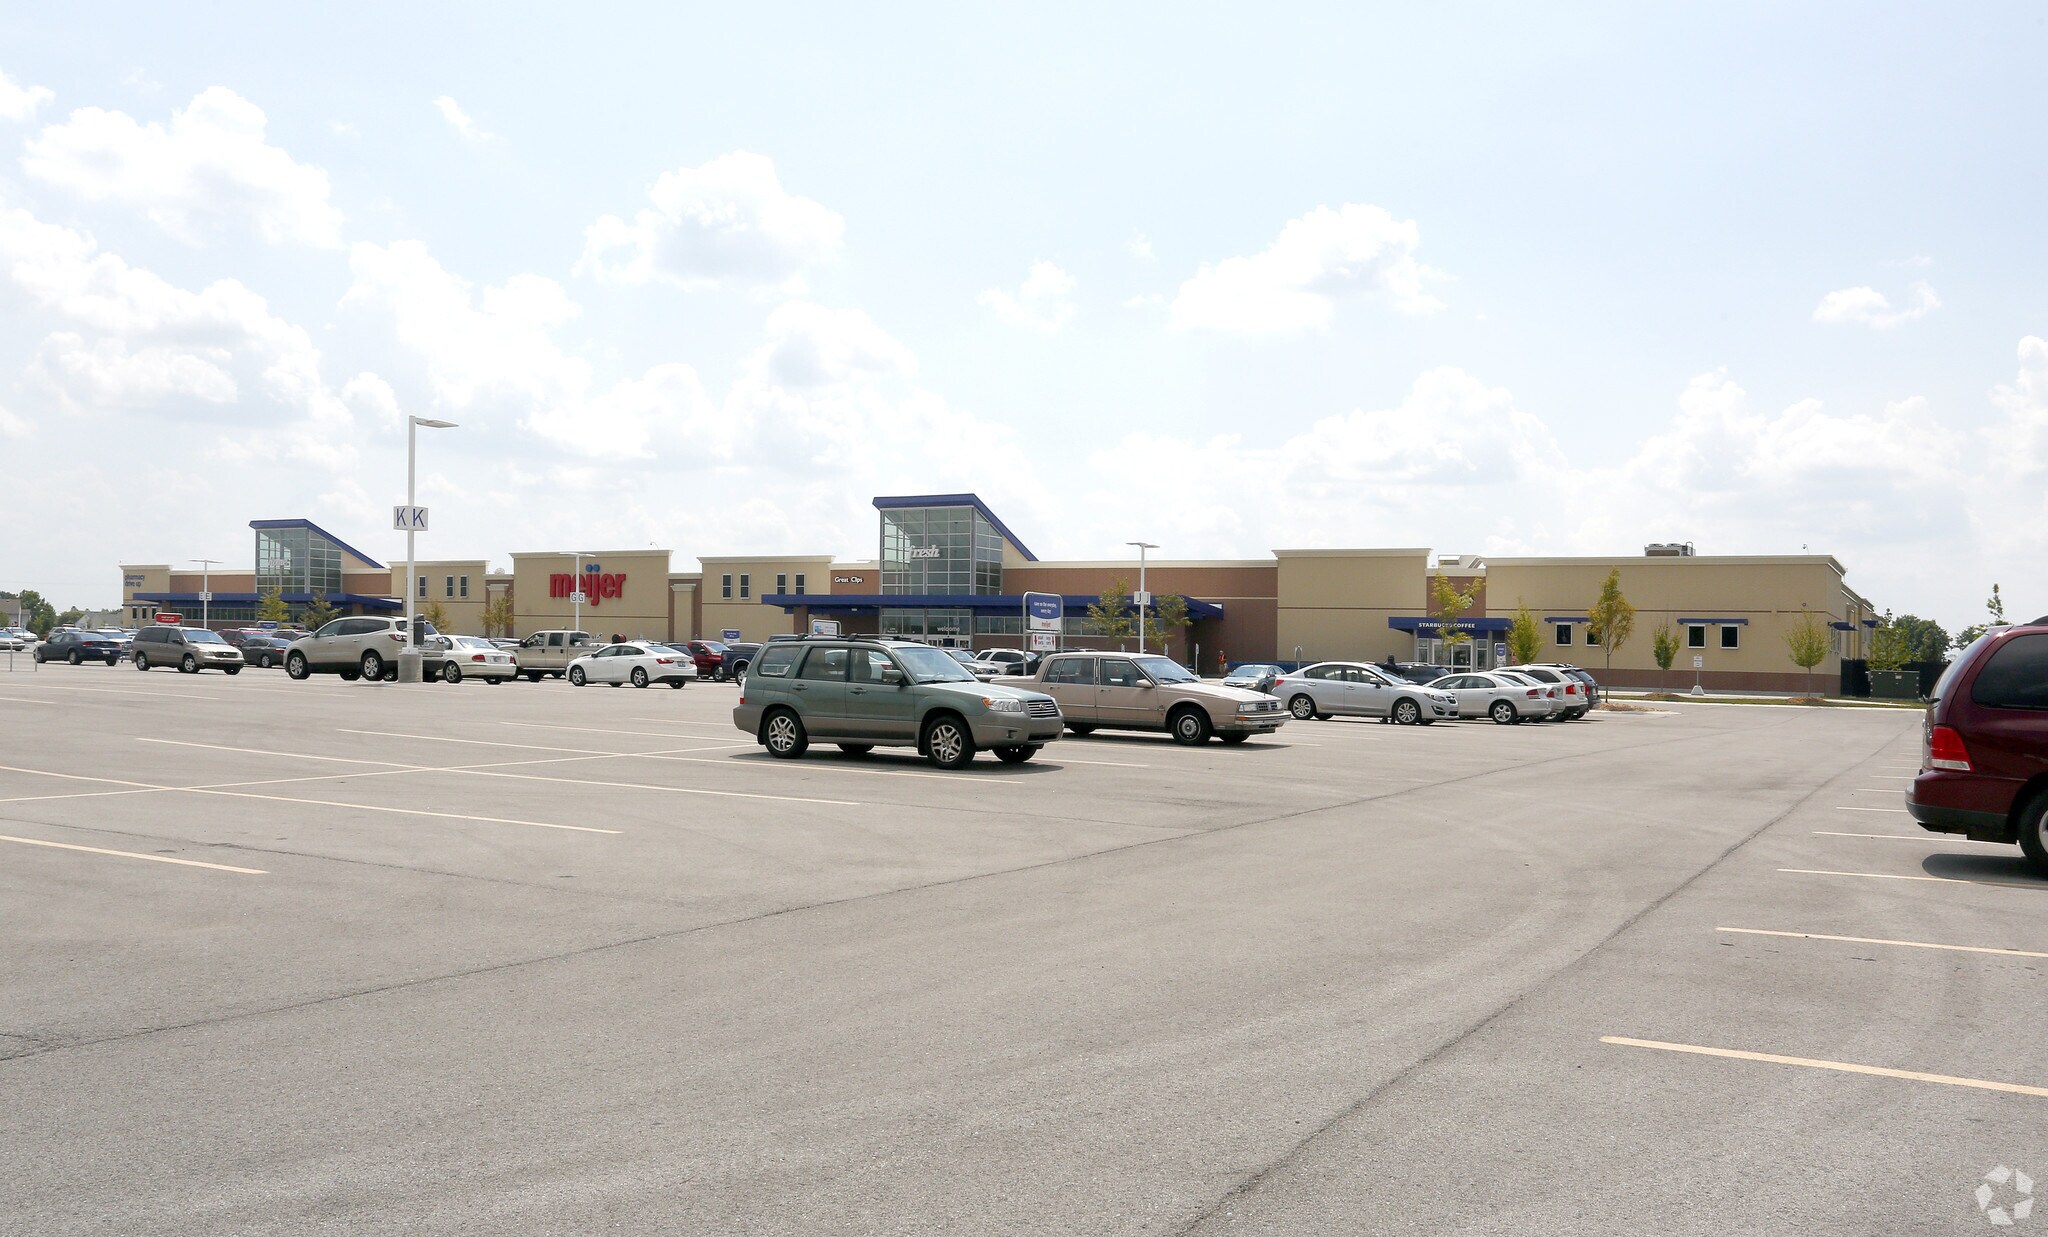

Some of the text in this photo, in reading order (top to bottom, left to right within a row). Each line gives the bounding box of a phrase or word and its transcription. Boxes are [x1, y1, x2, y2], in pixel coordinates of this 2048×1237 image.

[396, 508, 406, 527] K
[412, 508, 425, 528] K
[908, 544, 940, 559] fresh
[550, 564, 626, 607] meijer
